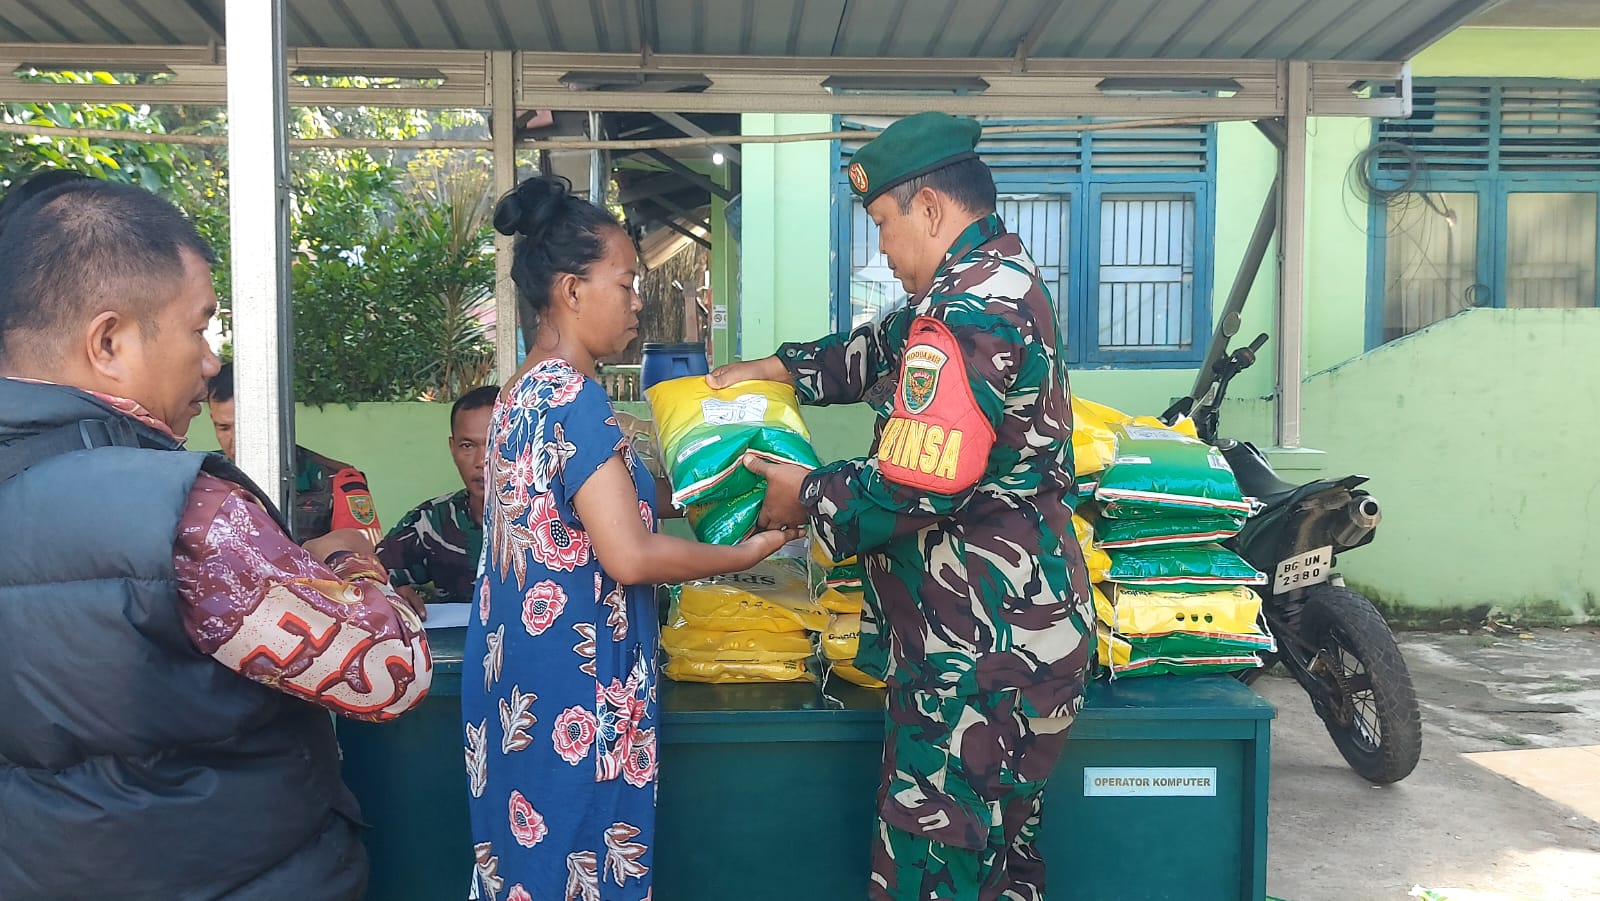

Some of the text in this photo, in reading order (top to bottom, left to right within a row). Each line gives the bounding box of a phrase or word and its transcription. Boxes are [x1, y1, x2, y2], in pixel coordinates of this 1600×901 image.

[1284, 554, 1320, 573] BG UN
[1283, 568, 1320, 586] 2380
[1094, 777, 1211, 787] OPERATOR KOMPUTER
